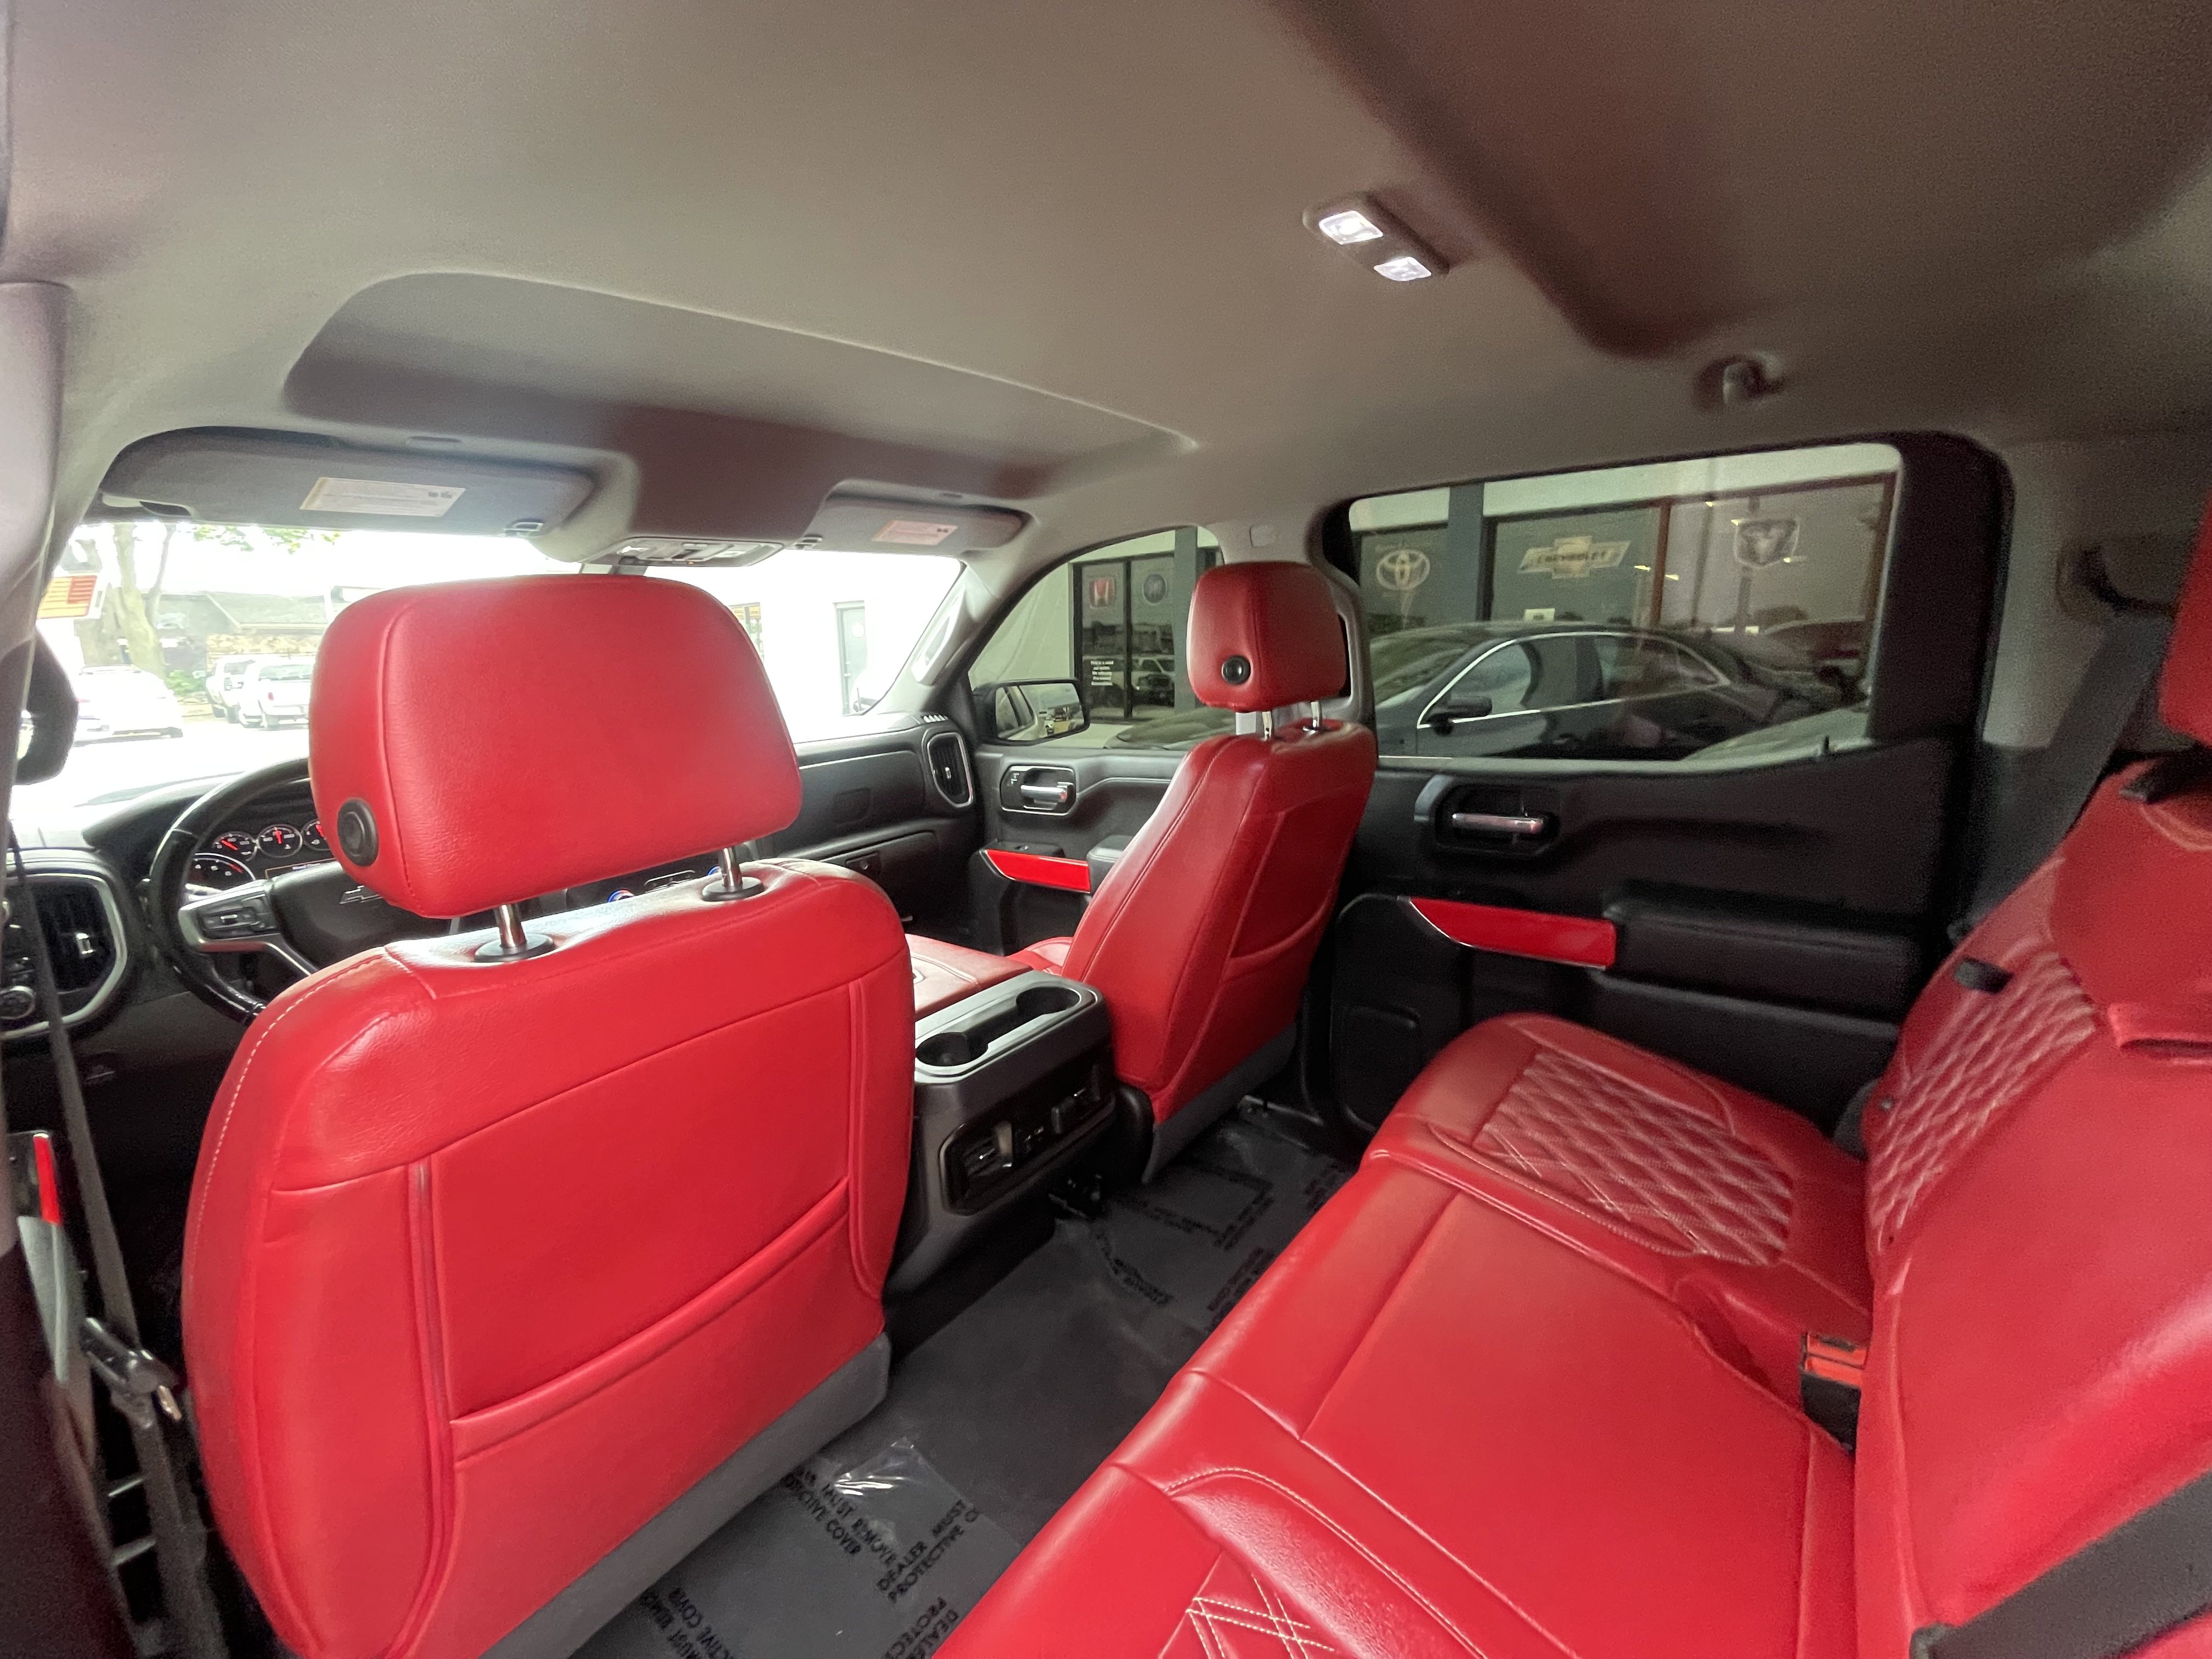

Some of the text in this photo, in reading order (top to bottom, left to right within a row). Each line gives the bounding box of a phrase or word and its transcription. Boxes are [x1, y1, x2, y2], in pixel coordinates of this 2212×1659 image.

[826, 1518, 862, 1555] COVER
[876, 1541, 928, 1591] DEALER
[888, 1524, 964, 1604] PROTECTIVE
